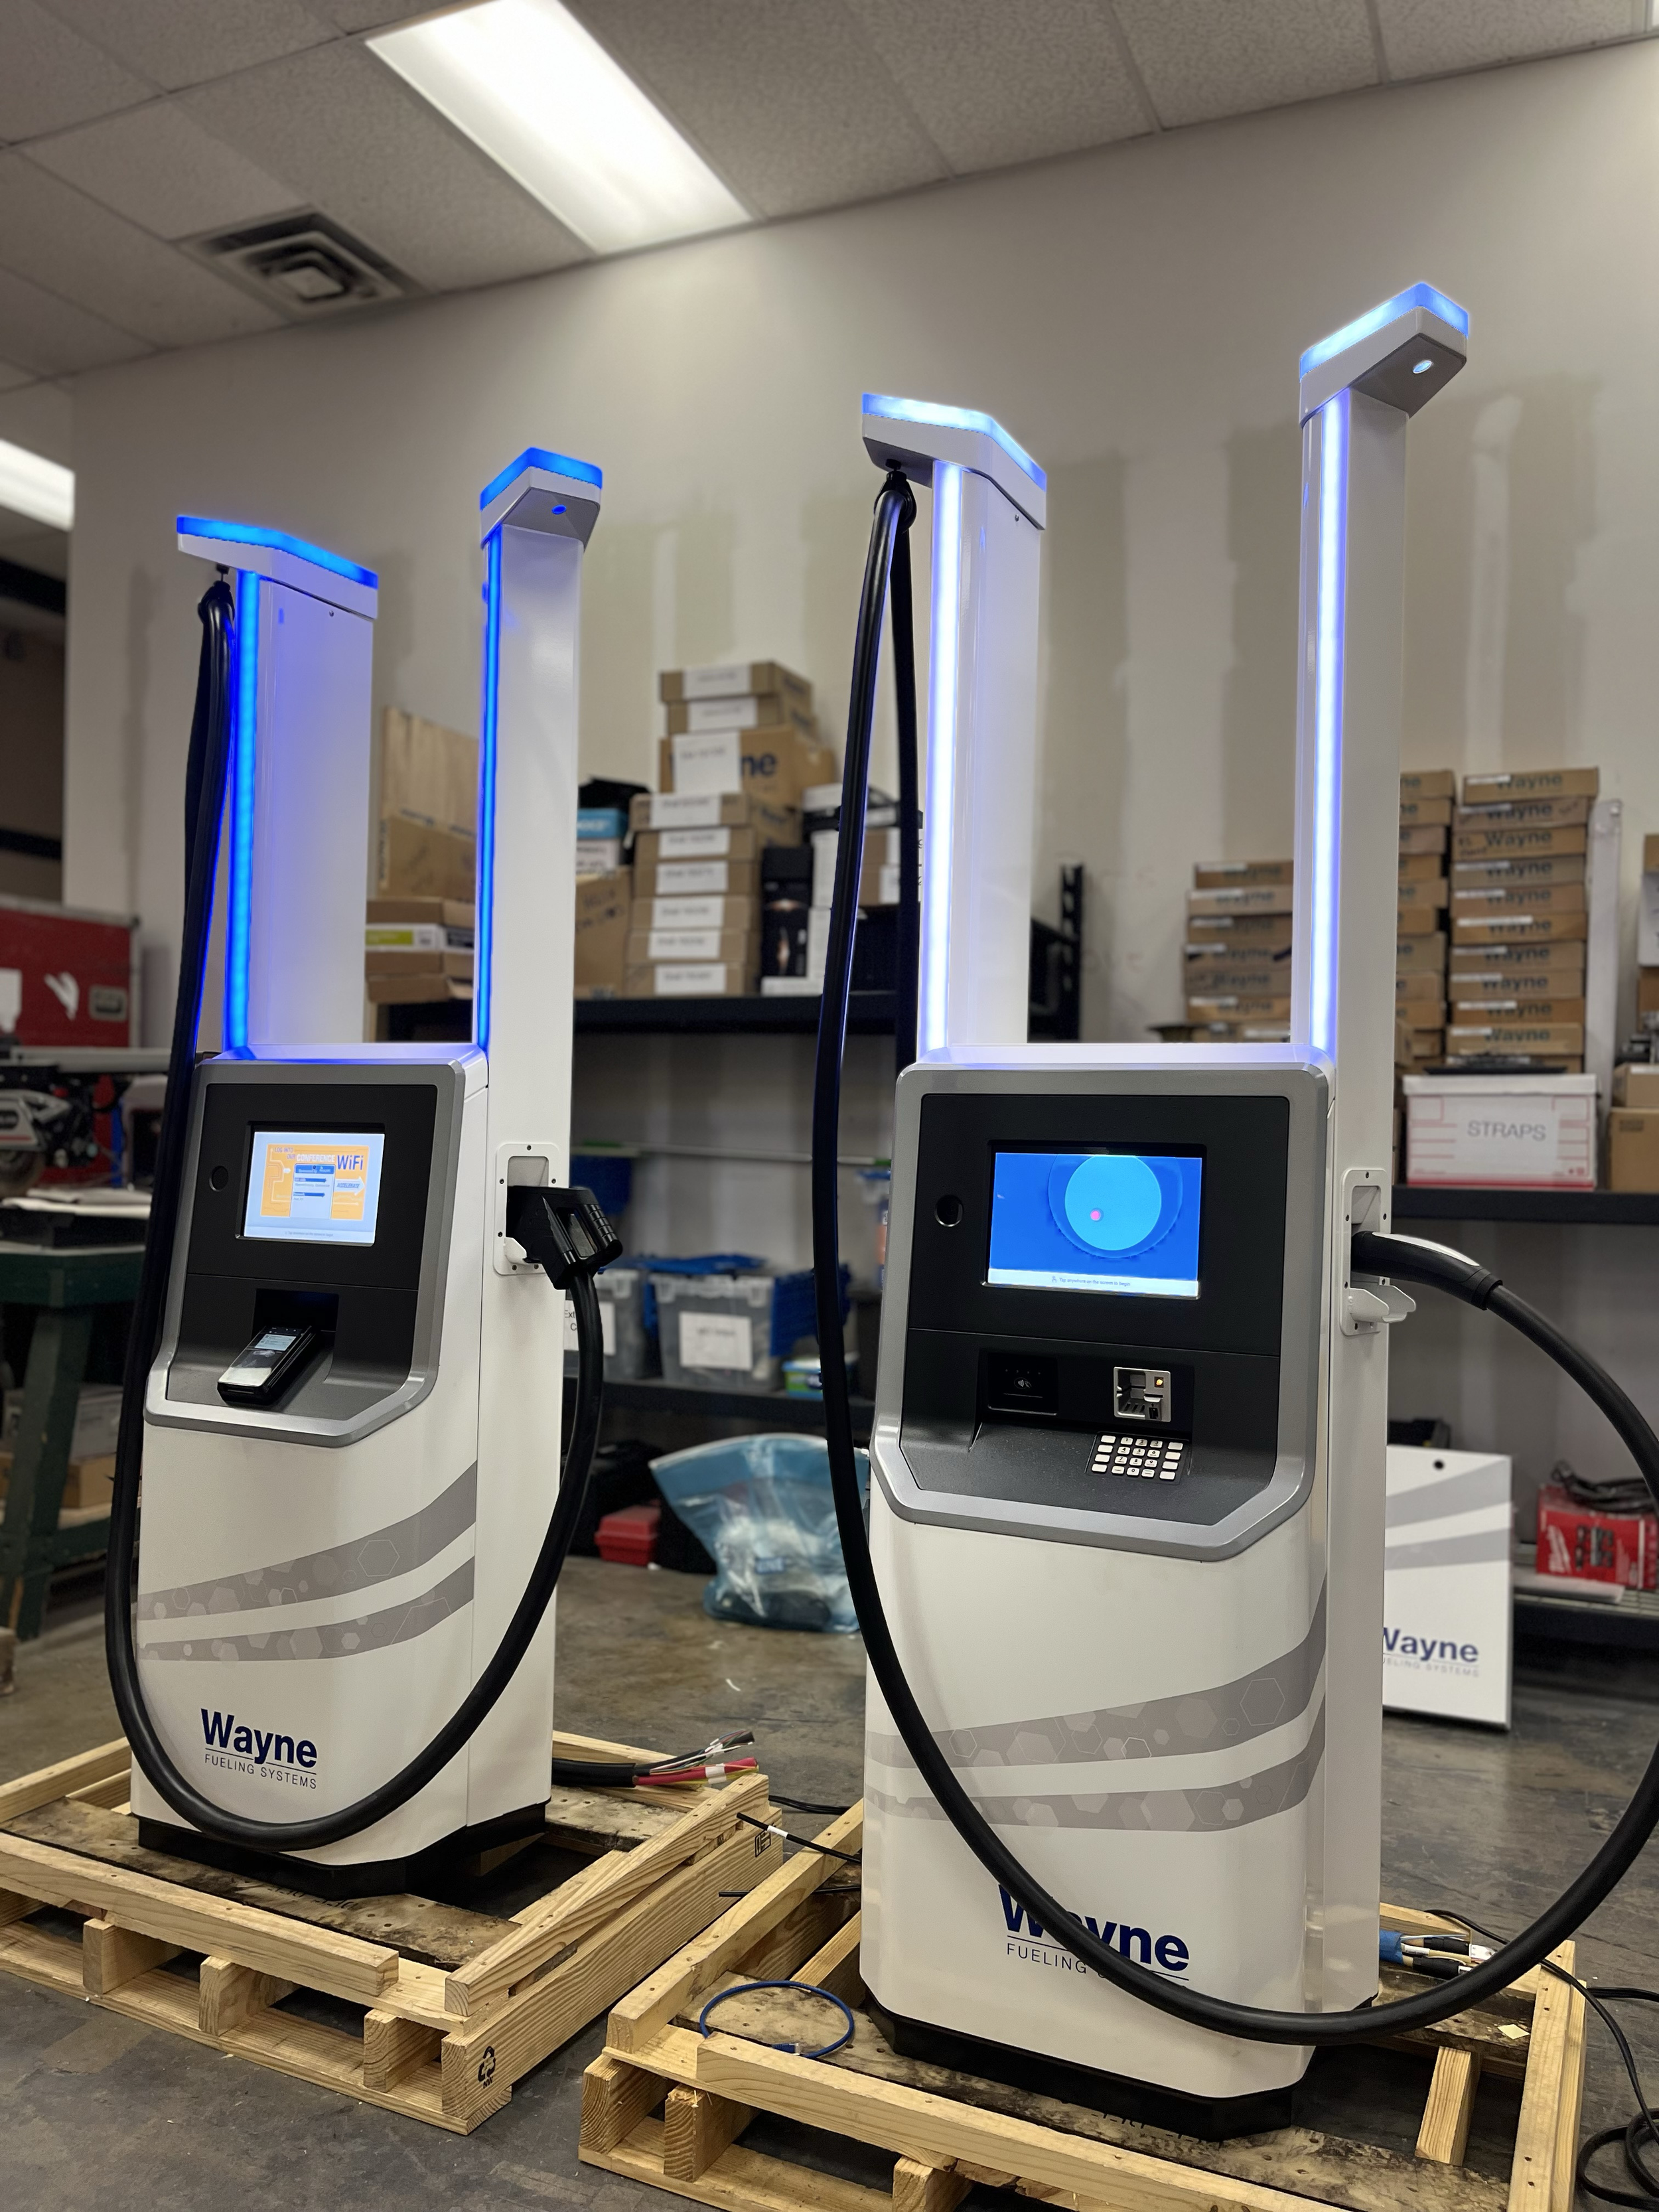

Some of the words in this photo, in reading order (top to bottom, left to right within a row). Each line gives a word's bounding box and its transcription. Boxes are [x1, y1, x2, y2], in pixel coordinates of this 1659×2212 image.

[1485, 831, 1552, 847] Wayne
[1467, 1119, 1547, 1142] STRAPS
[297, 1153, 335, 1163] CONFERENCE
[337, 1155, 364, 1170] WiFi
[1384, 1657, 1420, 1670] ELING
[1426, 1664, 1480, 1678] SYSTEMS
[200, 1708, 317, 1768] Wayne
[204, 1753, 255, 1775] FUELING
[260, 1767, 317, 1789] SYSTEMS
[998, 1884, 1189, 1972] Wyne
[1007, 1943, 1086, 1974] FUELING
